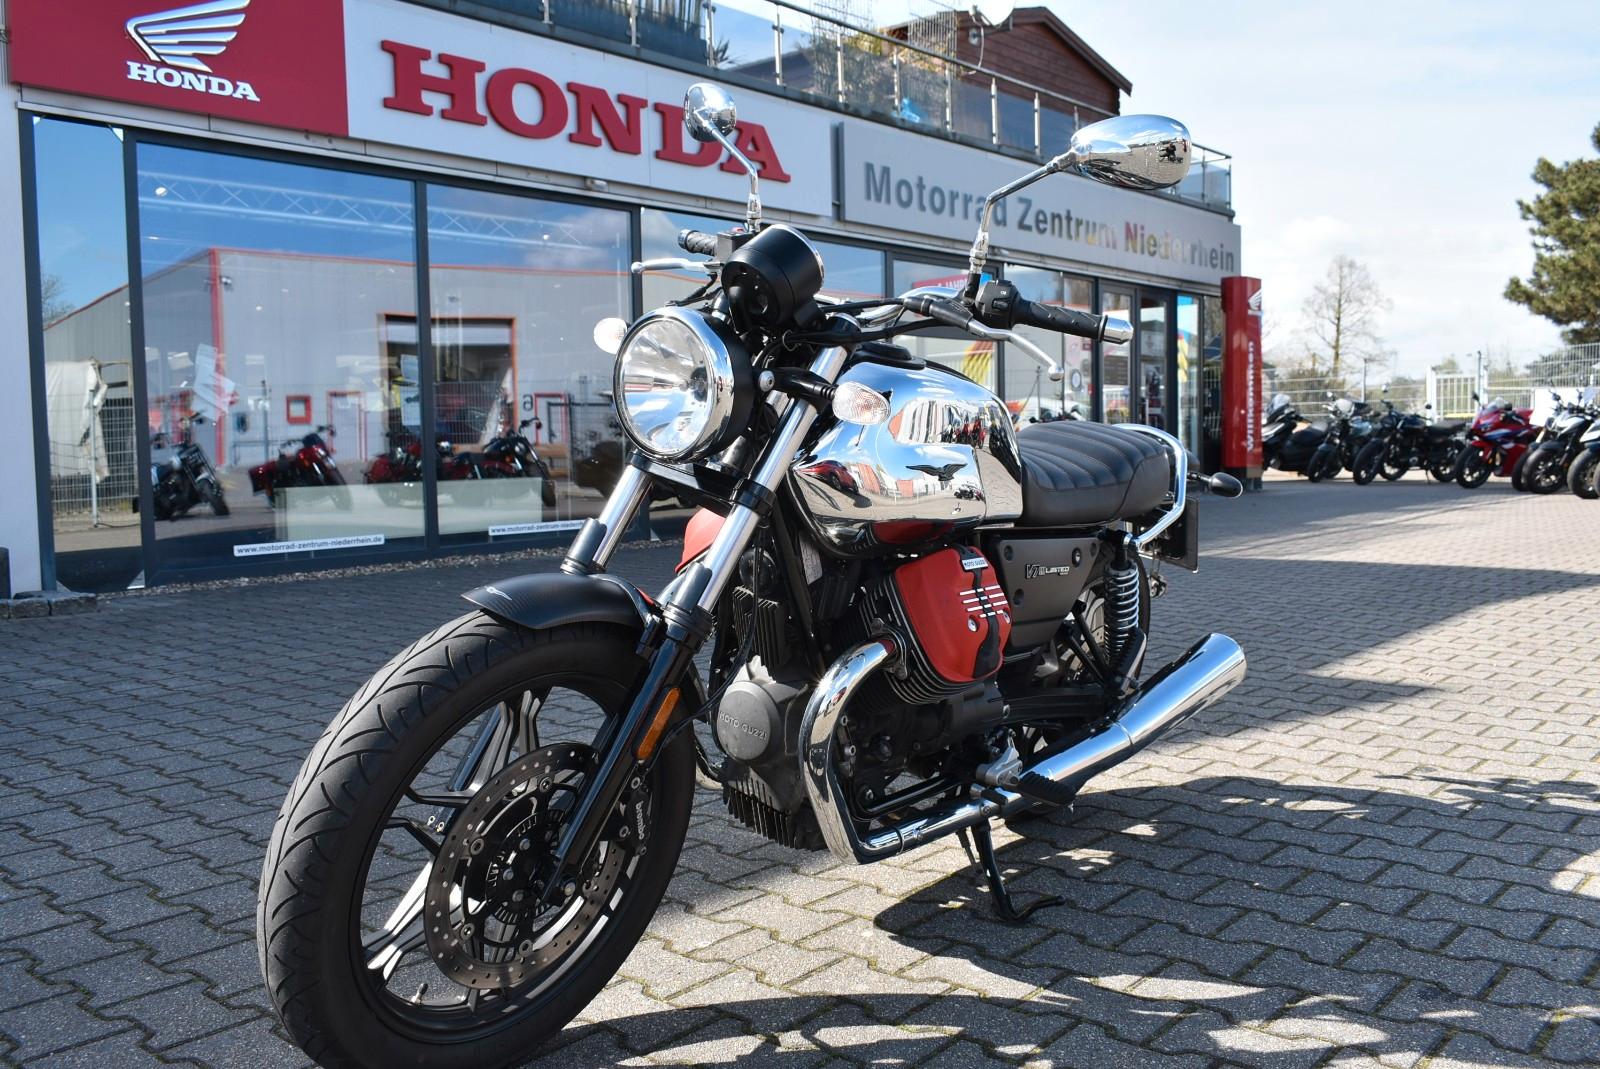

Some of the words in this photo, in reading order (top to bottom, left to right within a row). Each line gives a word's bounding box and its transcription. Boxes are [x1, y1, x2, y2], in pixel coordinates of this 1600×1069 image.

[126, 61, 261, 103] HONDA
[380, 40, 791, 184] HONDA
[864, 162, 1007, 228] Motorrad
[1017, 197, 1117, 250] Zentrum
[1124, 221, 1235, 273] Niederrhein
[237, 535, 383, 554] www.motorrad-zentrum-niederrhein.de
[720, 711, 740, 728] MOTO
[741, 722, 767, 741] GUZZI
